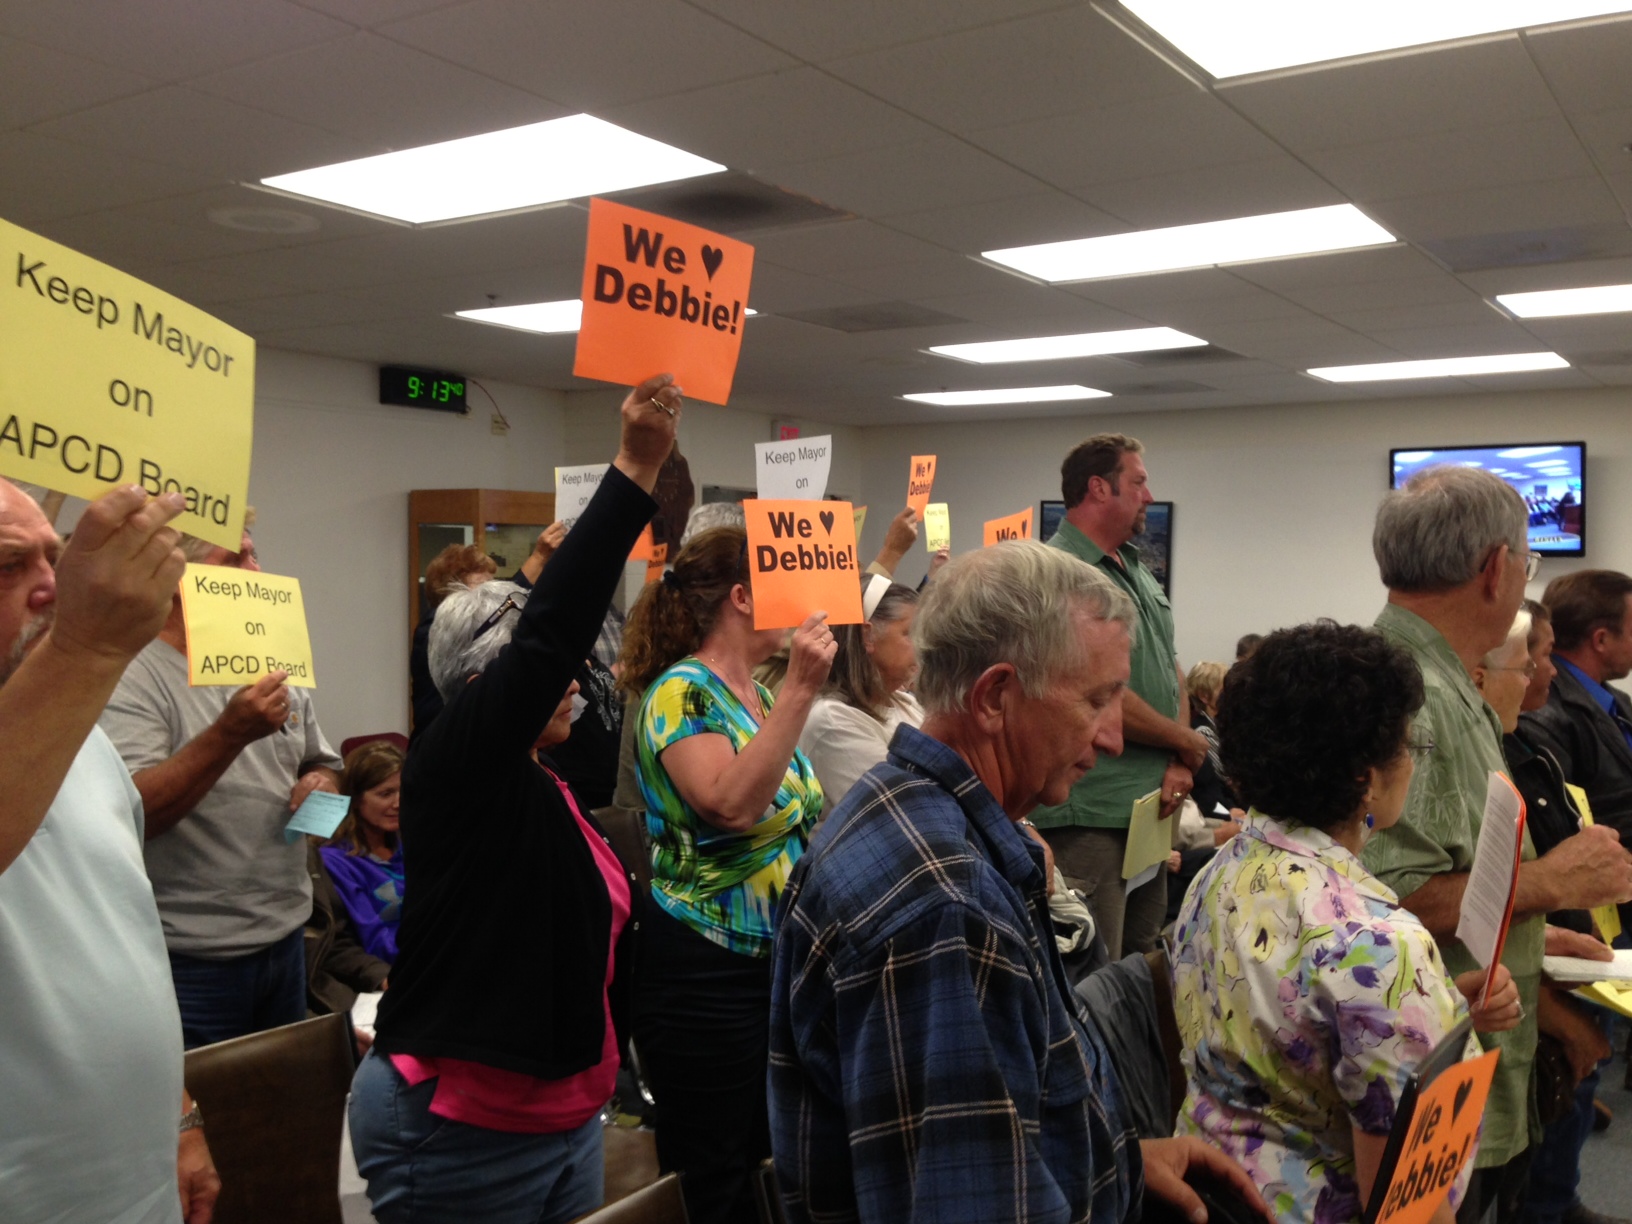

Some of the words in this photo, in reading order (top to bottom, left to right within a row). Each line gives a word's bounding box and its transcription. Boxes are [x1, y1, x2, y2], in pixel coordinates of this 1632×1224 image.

[623, 223, 687, 275] We
[593, 263, 741, 335] Debbie!
[16, 252, 119, 329] Keep
[133, 301, 235, 377] Mayor
[109, 378, 154, 417] on
[0, 414, 124, 483] APCD
[764, 450, 796, 465] Keep
[798, 446, 827, 462] Mayor
[562, 473, 582, 487] Keep
[583, 472, 604, 485] Mayo
[795, 477, 809, 489] on
[915, 462, 926, 478] We
[768, 511, 813, 538] We
[756, 543, 854, 573] Debbie!
[194, 575, 242, 601] Keep
[245, 580, 292, 606] Mayor
[245, 620, 266, 636] on
[200, 654, 260, 675] APCD
[1405, 1097, 1442, 1161] We
[1382, 1132, 1471, 1221] ebbie!
